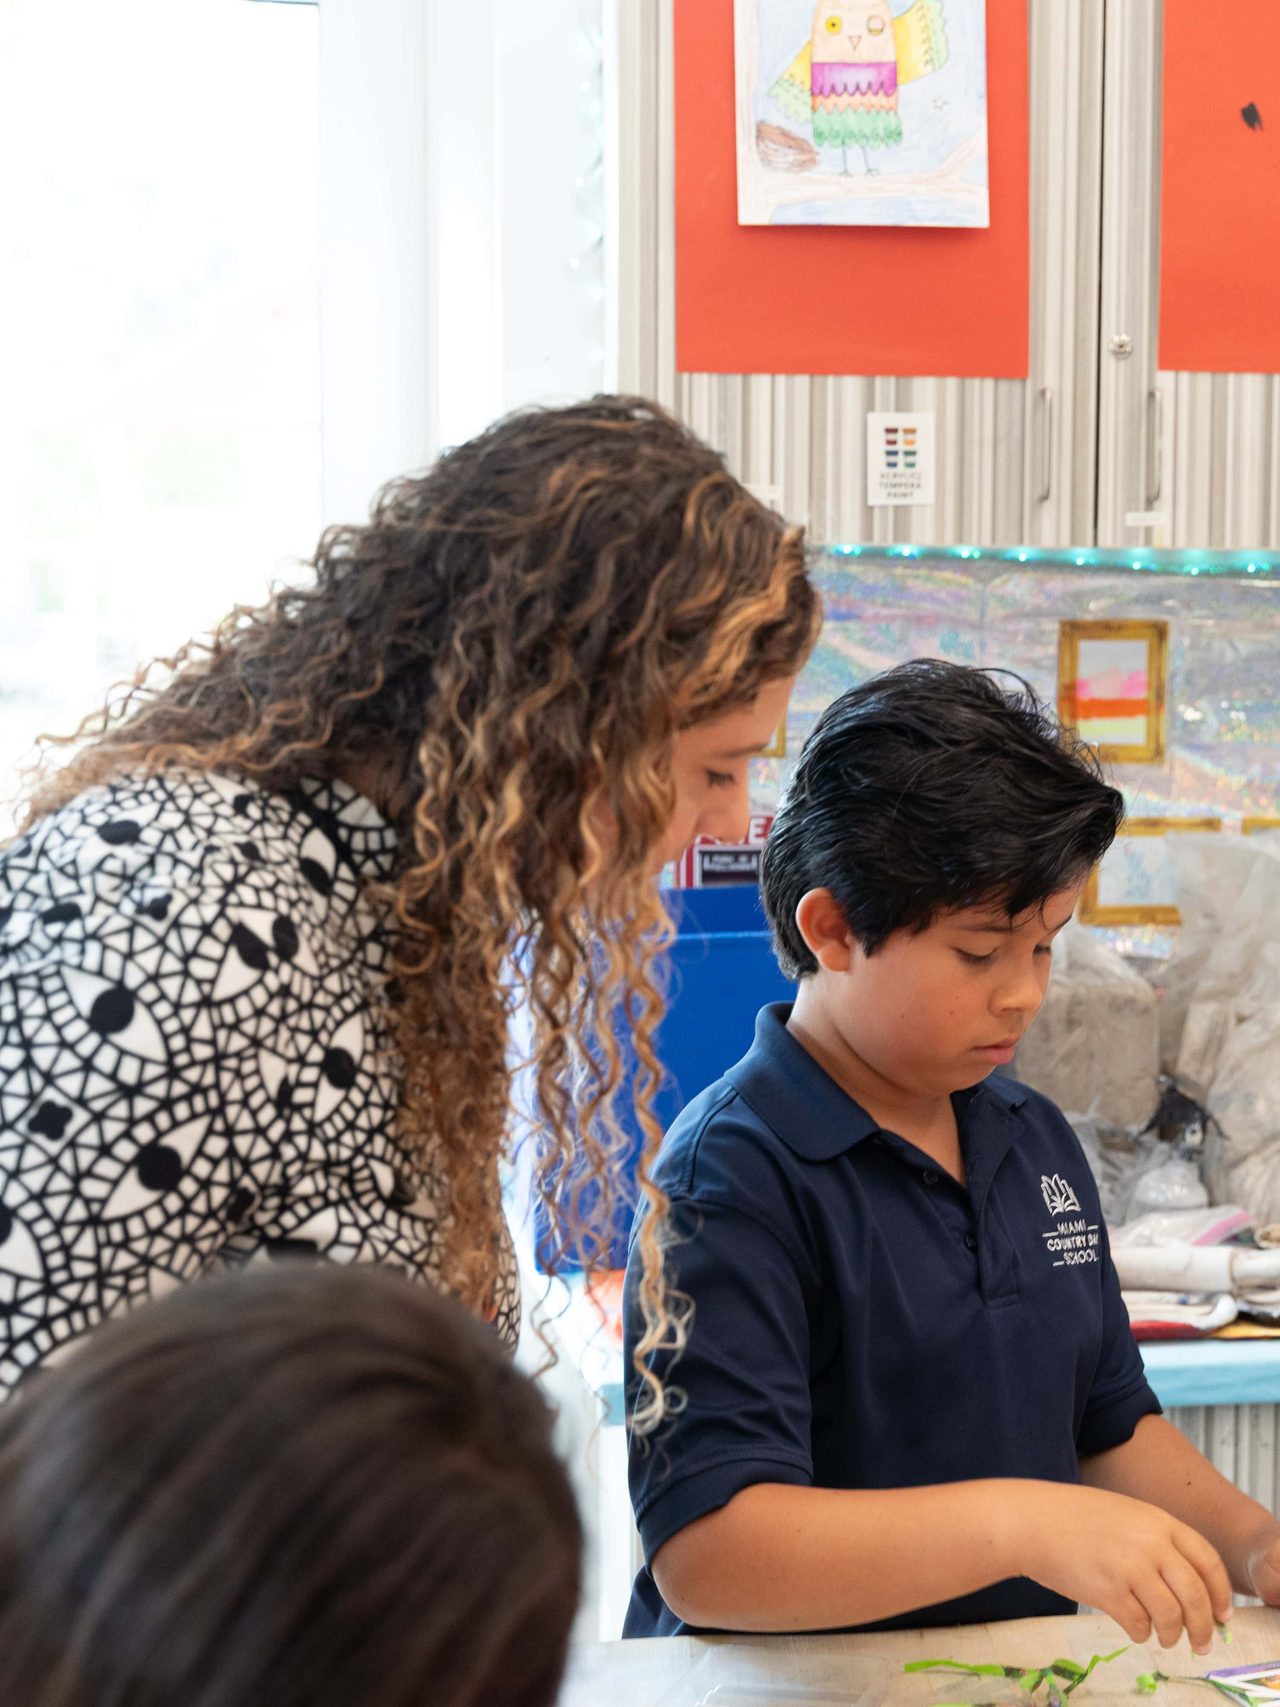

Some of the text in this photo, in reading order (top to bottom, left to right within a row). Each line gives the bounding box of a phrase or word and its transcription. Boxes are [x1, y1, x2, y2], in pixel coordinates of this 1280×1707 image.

[880, 481, 922, 490] TEMPERA
[886, 491, 913, 499] PAINT
[1056, 1218, 1087, 1235] MIAMI
[1046, 1234, 1087, 1252] COUNTRY
[1063, 1248, 1098, 1266] SCHOOL
